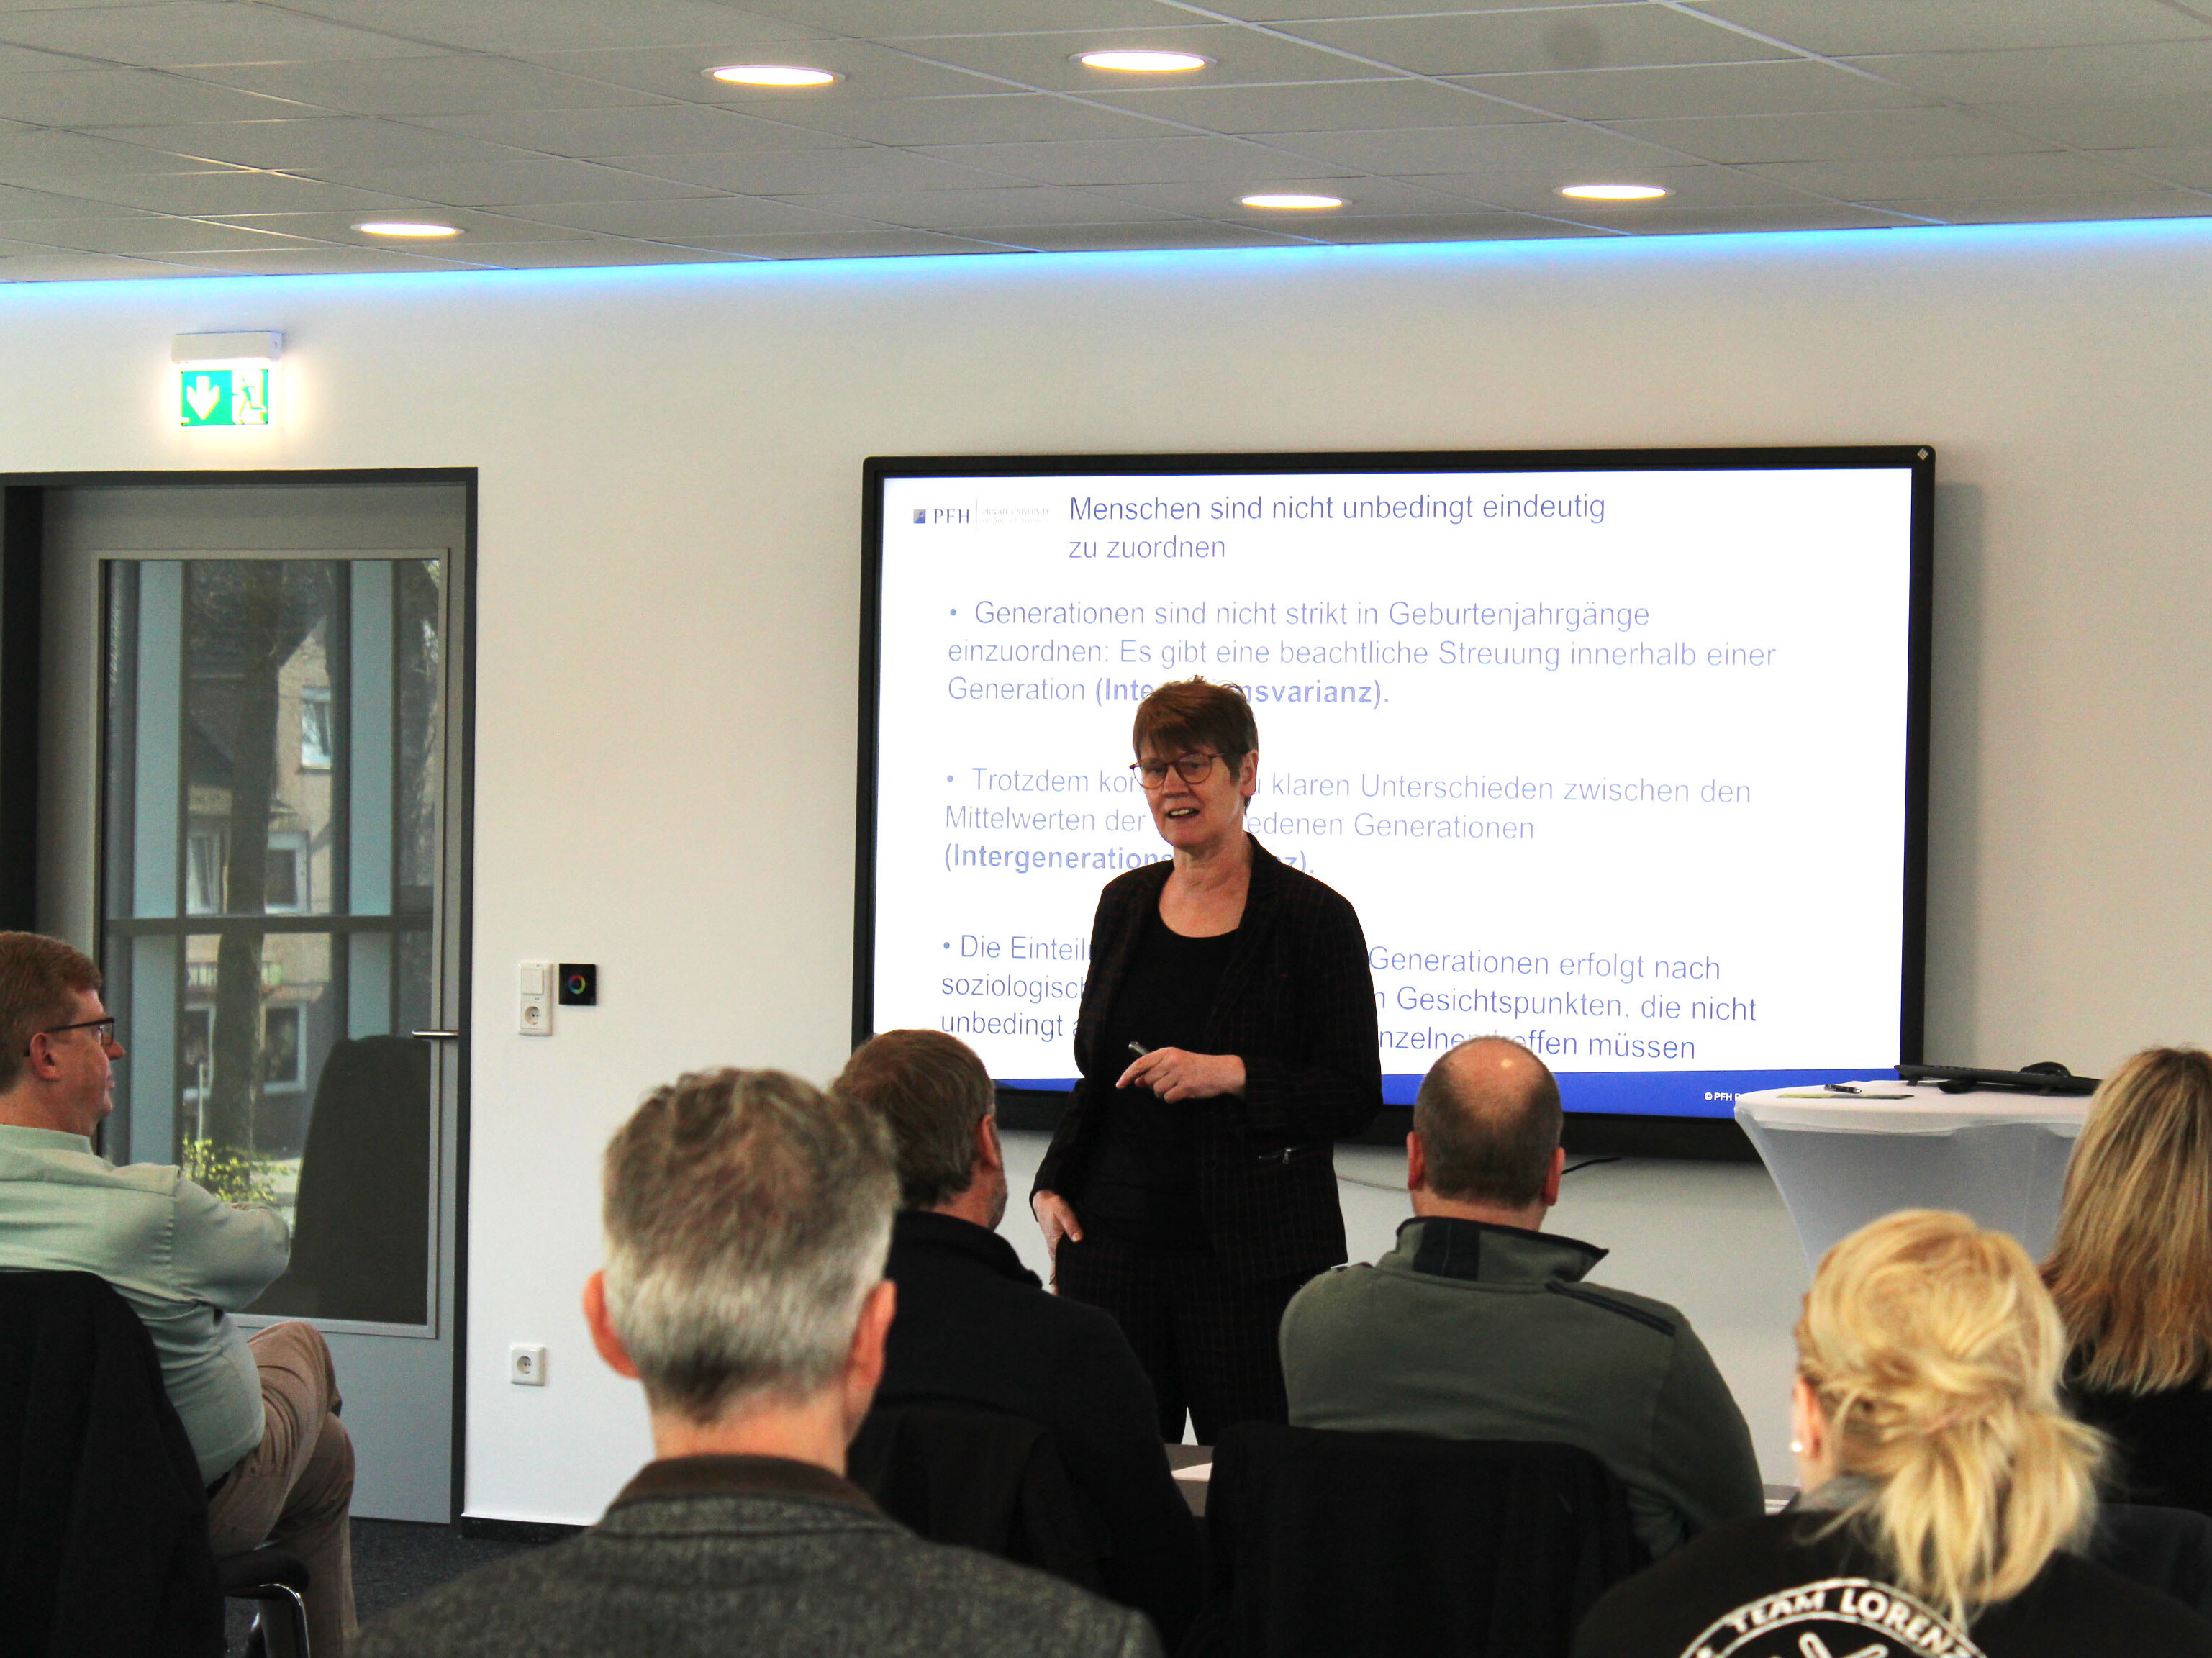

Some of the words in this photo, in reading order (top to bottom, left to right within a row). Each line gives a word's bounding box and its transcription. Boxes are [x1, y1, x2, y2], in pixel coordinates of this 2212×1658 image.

[933, 508, 969, 525] PFH
[1070, 496, 1200, 521] Menschen
[1210, 495, 1262, 520] sind
[1272, 494, 1334, 520] nicht
[1343, 494, 1474, 525] unbedingt
[1482, 492, 1605, 525] eindeutig
[1068, 540, 1097, 559] zu
[1106, 535, 1225, 559] zuordnen
[975, 599, 1144, 625] Generationen
[1155, 601, 1205, 625] sind
[1216, 601, 1277, 625] nicht
[1286, 601, 1348, 625] strikt
[1358, 601, 1378, 625] in
[1389, 601, 1649, 633] Geburtenjahrgänge
[948, 638, 1109, 663] einzuordnen:
[1120, 638, 1151, 663] Es
[1161, 639, 1207, 669] gibt
[1216, 640, 1269, 663] eine
[1280, 640, 1428, 665] beachtliche
[1438, 640, 1559, 672] Streuung
[1571, 641, 1696, 666] innerhalb
[1707, 641, 1777, 666] einer
[948, 676, 1085, 701] Generation
[1095, 676, 1390, 709] (Intensvarianz).
[971, 767, 1089, 792] Trotzdem
[1272, 771, 1350, 797] klaren
[1361, 773, 1553, 800] Unterschieden
[1563, 776, 1689, 802] zwischen
[1700, 779, 1751, 804] den
[946, 805, 1095, 831] Mittelwerten
[1105, 808, 1146, 832] der
[1354, 811, 1533, 840] Generationen
[961, 933, 1001, 959] Die
[1011, 936, 1089, 962] Einteil
[1369, 946, 1549, 976] Generationen
[1559, 951, 1644, 984] erfolgt
[1655, 955, 1720, 980] nach
[1397, 985, 1629, 1020] Gesichtspunkten,
[1641, 994, 1681, 1020] die
[1692, 995, 1757, 1022] nicht
[941, 1010, 1064, 1043] unbedingt
[1589, 1032, 1695, 1060] müssen
[1714, 1092, 1732, 1101] PFH
[1728, 1591, 1826, 1633] TEAM
